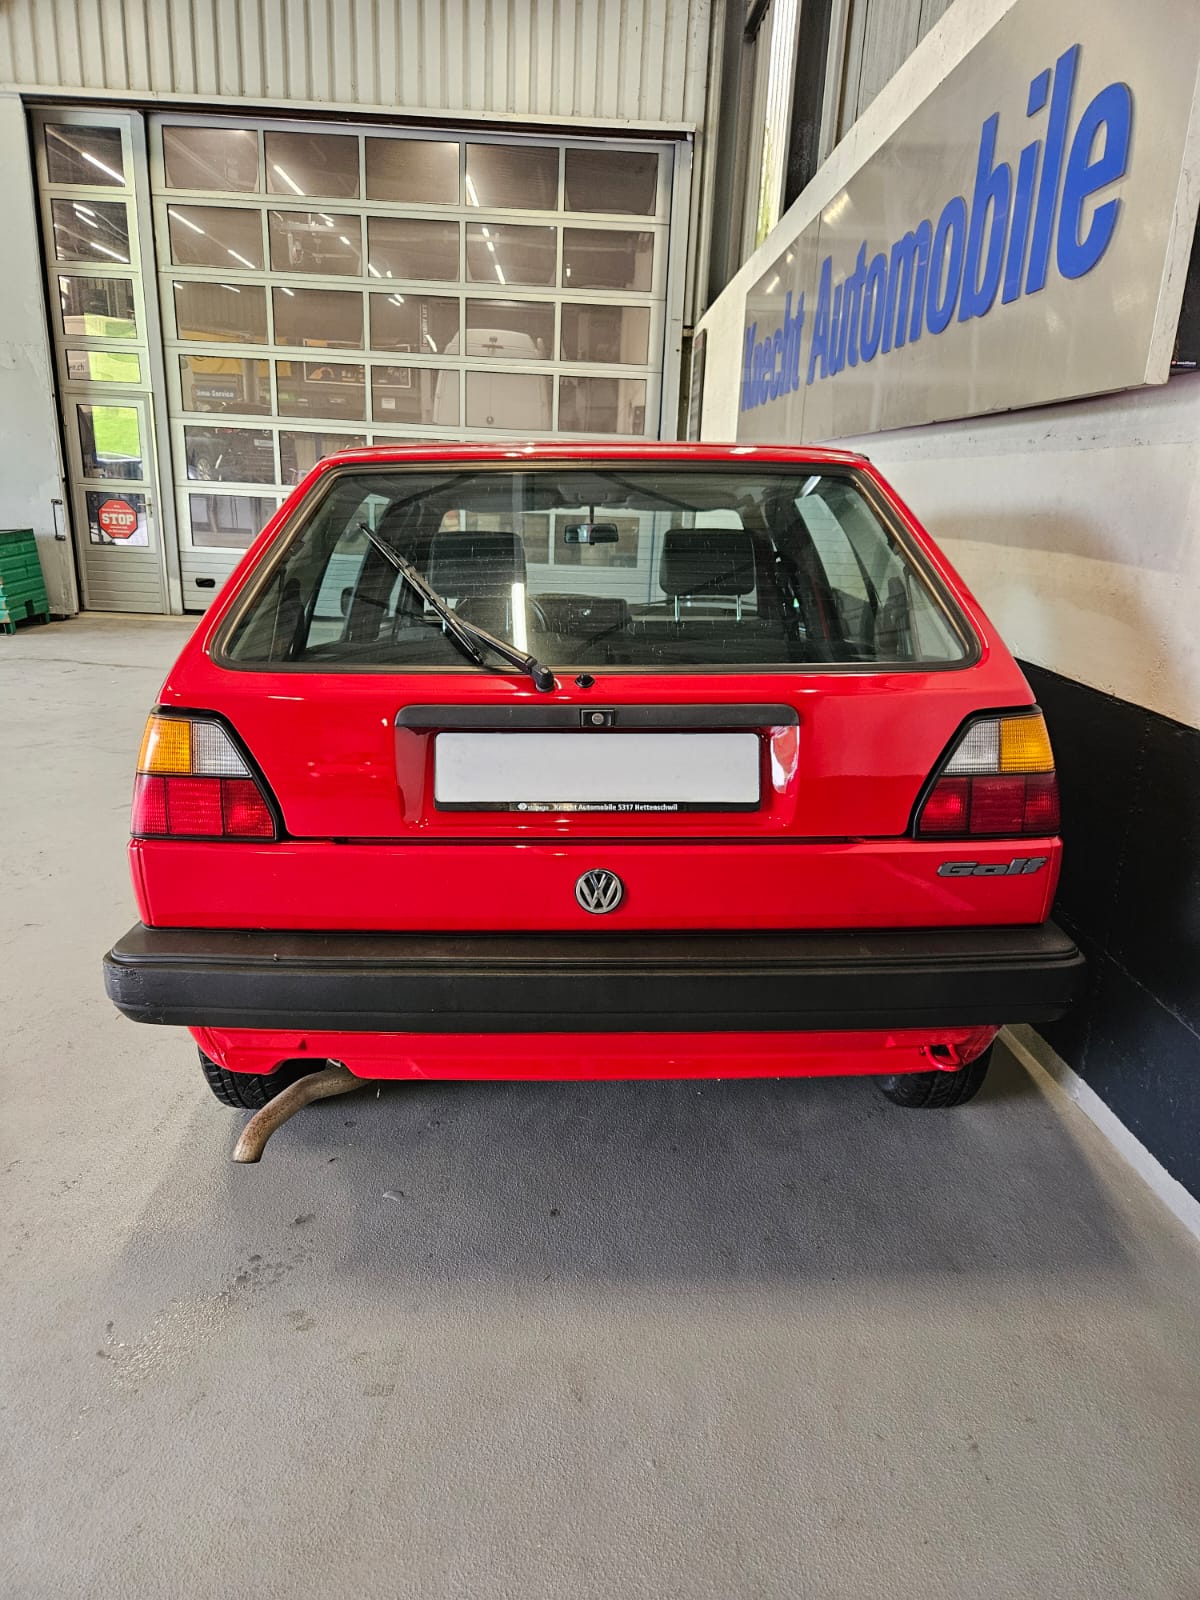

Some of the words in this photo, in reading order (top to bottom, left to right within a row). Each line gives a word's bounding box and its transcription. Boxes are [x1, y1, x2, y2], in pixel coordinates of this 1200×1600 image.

[741, 290, 805, 412] Knecht
[807, 43, 1134, 386] Automobile
[101, 513, 134, 525] STOP
[936, 856, 1048, 878] Golf
[576, 868, 624, 914] VW
